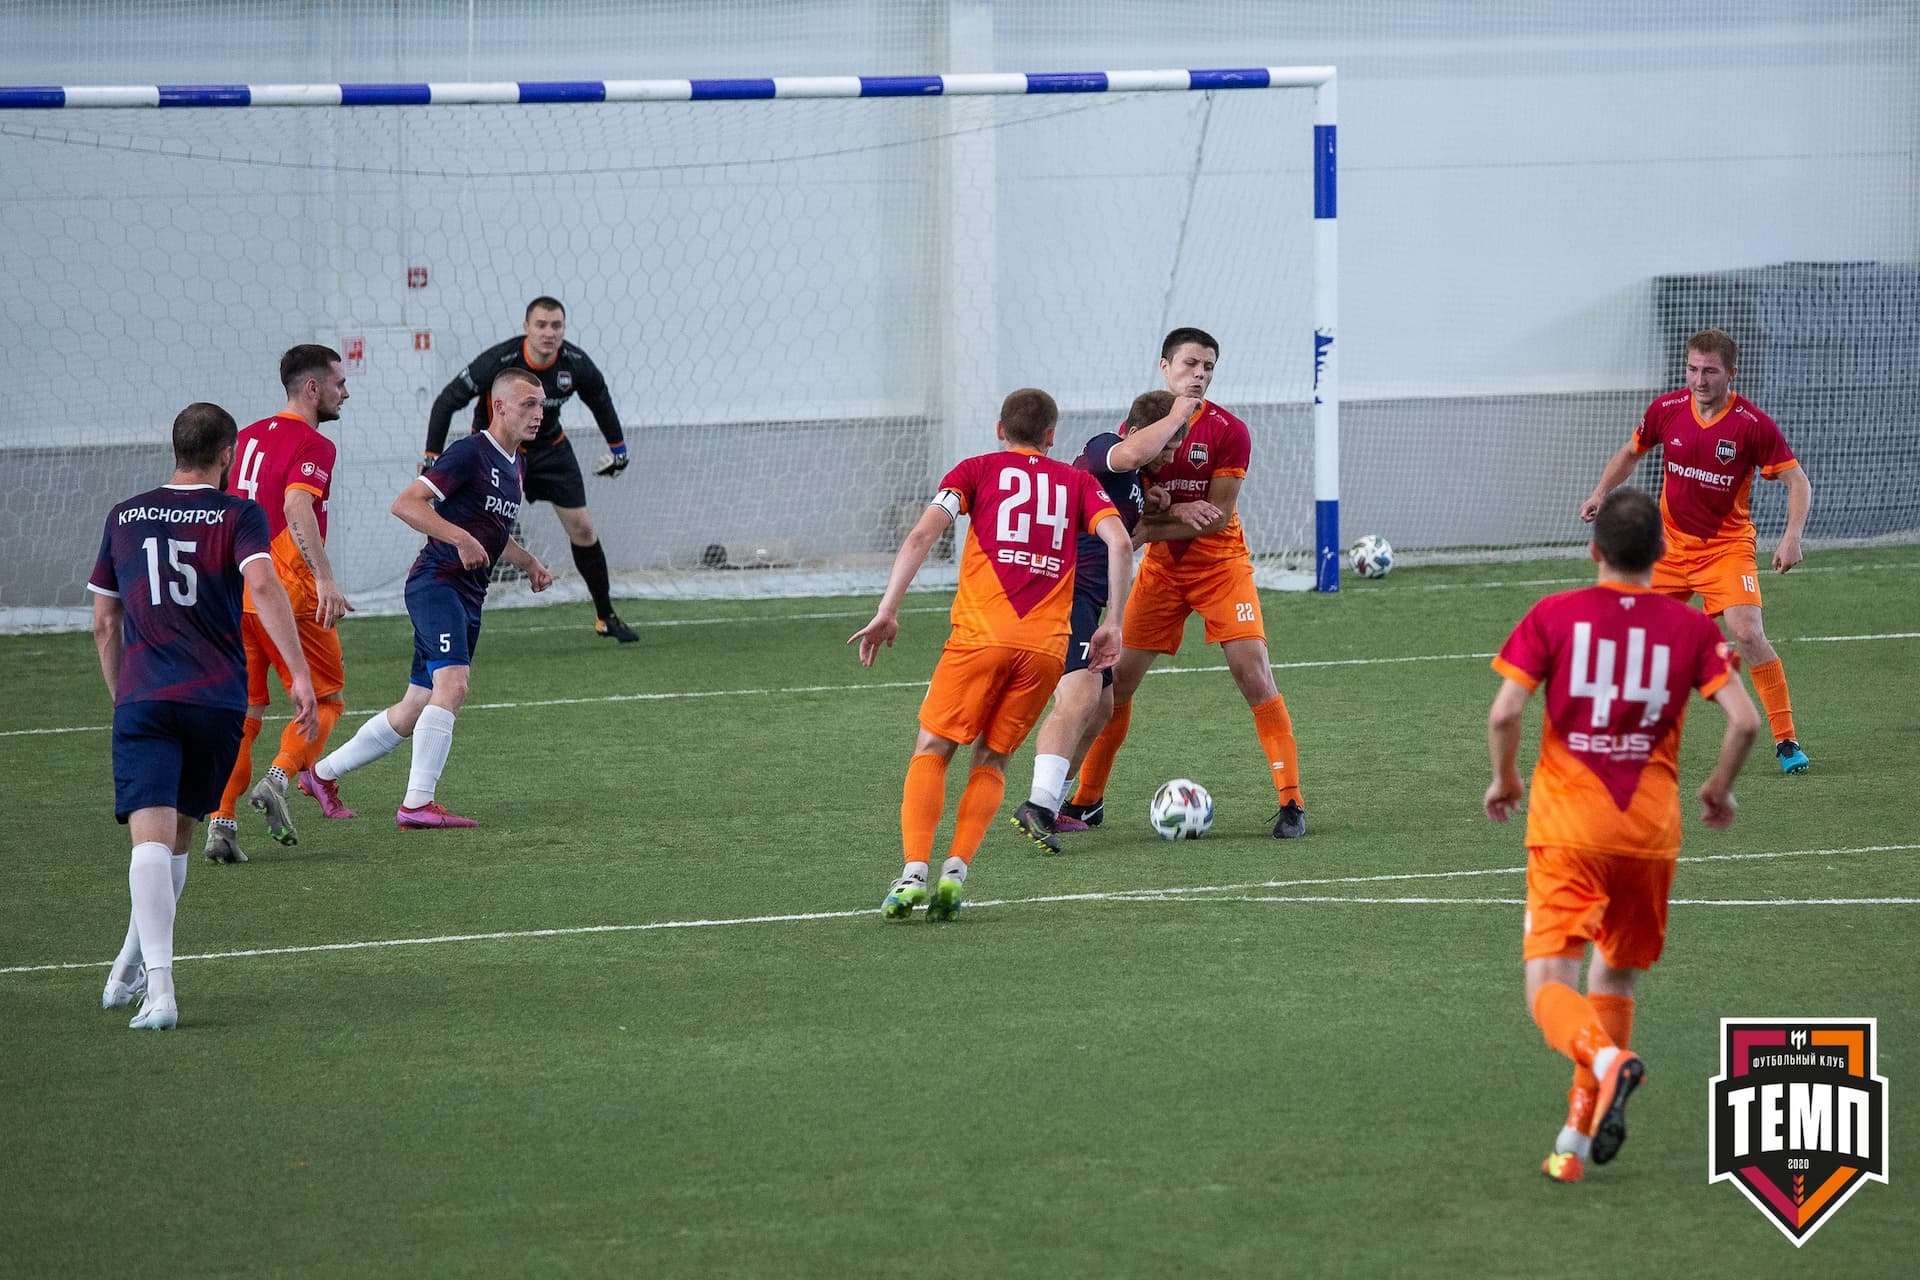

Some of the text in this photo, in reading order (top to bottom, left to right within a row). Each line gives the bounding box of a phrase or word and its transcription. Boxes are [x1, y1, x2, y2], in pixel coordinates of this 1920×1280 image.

[237, 438, 265, 500] 4
[491, 468, 500, 487] 5
[1668, 461, 1735, 487] ПРОДИНВЕСТ
[118, 507, 226, 526] КРАСНОЯРСК
[996, 467, 1069, 550] 24
[141, 537, 198, 606] 15
[997, 549, 1062, 572] SEUS
[1235, 602, 1255, 622] 22
[439, 633, 451, 652] 5
[1079, 642, 1090, 660] 7
[1570, 622, 1670, 728] 44
[1568, 732, 1651, 754] SEUS
